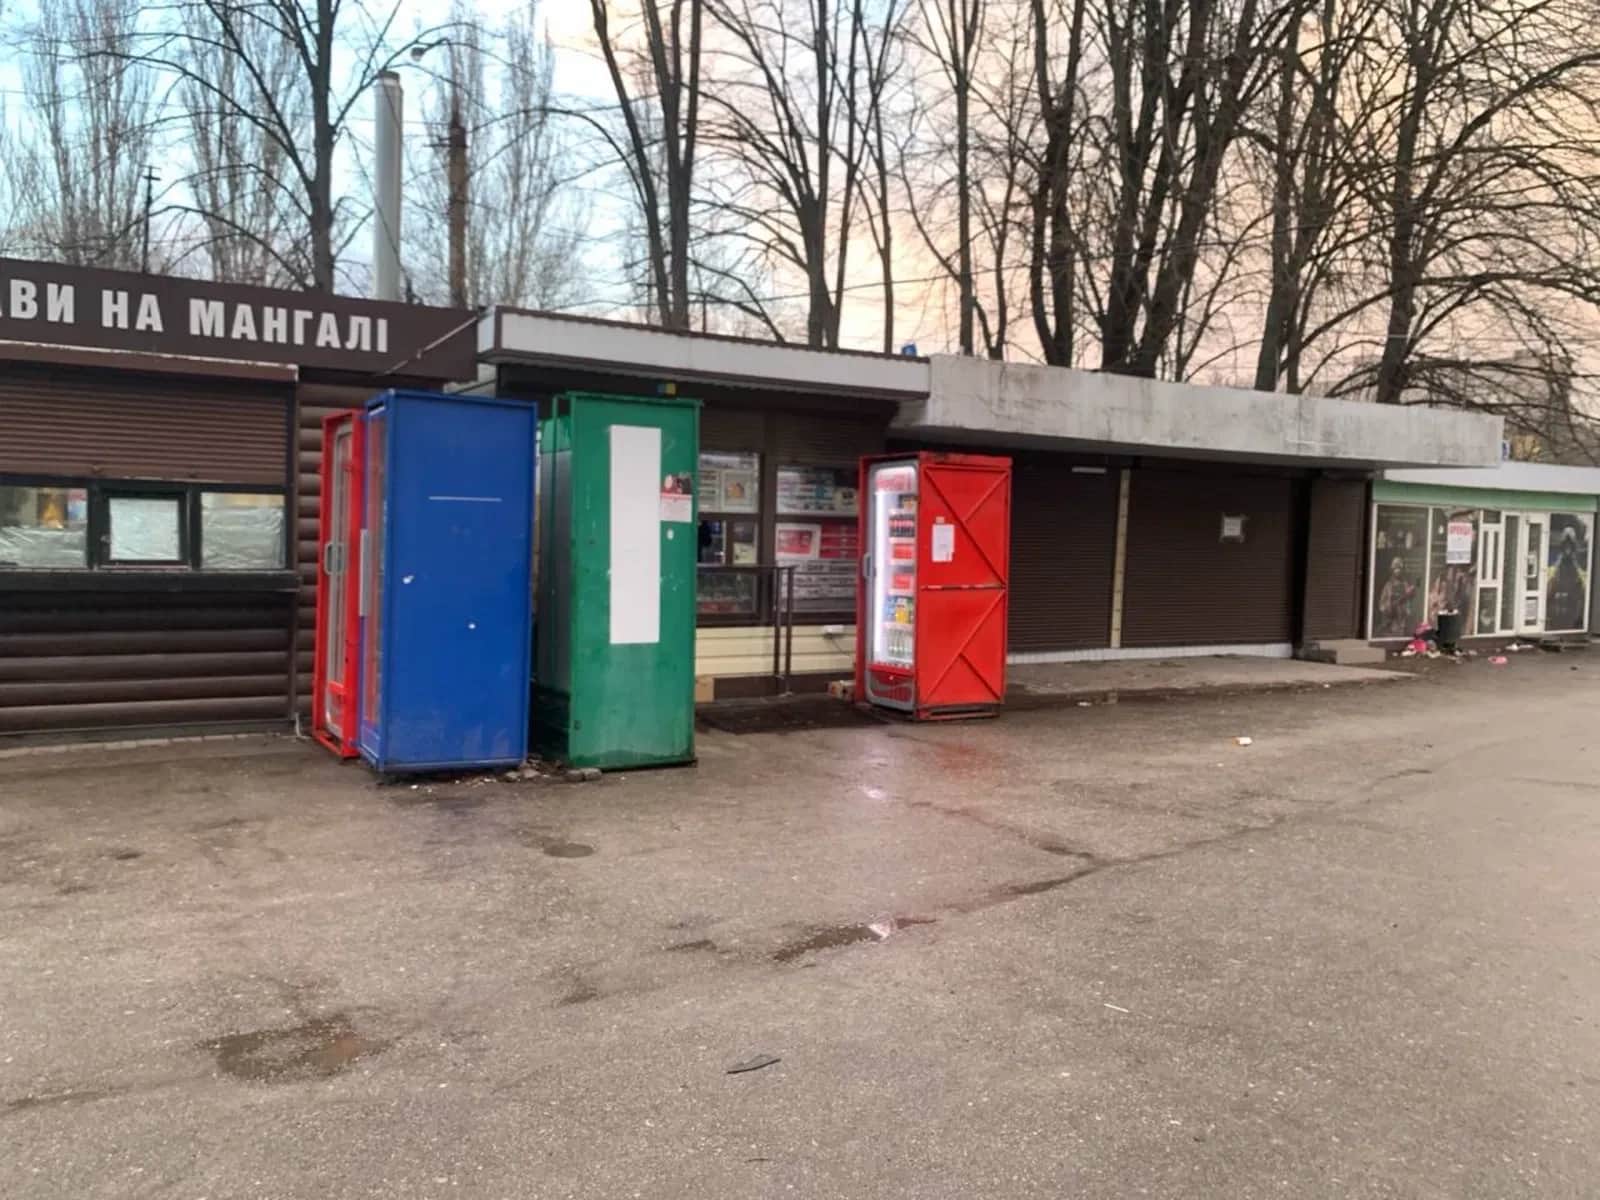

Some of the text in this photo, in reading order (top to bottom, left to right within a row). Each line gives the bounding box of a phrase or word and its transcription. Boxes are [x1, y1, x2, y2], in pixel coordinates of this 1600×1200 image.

[0, 279, 389, 353] ВИ НА МАНГАЛІ
